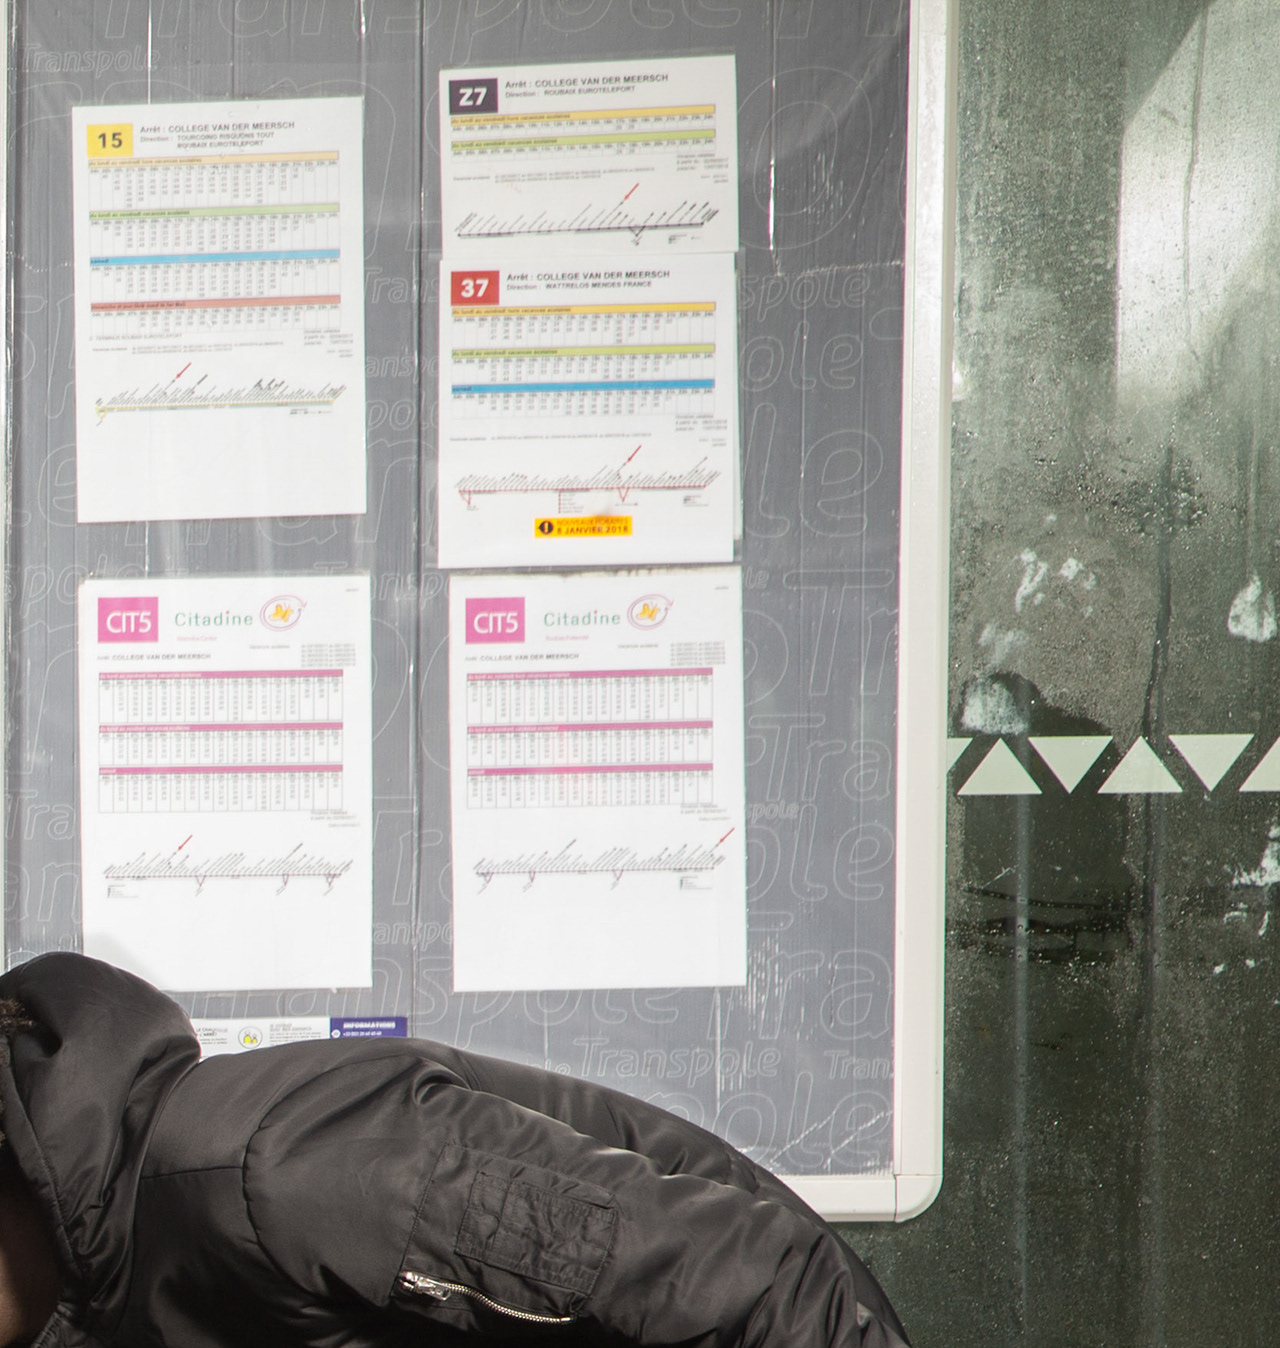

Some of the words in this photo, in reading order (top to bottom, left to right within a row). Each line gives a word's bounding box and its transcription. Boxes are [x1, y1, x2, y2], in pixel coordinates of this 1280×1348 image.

[506, 80, 526, 88] Arrêt
[535, 78, 578, 87] COLLEGE
[581, 77, 599, 86] VAN
[601, 76, 620, 85] DER
[623, 75, 668, 84] MEERSCH
[459, 87, 487, 106] Z7
[141, 125, 160, 133] Arrêt
[169, 123, 209, 132] COLLEGE
[213, 123, 230, 131] VAN
[232, 122, 250, 130] DER
[253, 122, 294, 130] MEERSCH
[98, 132, 122, 149] 15
[507, 273, 527, 281] Arrêt
[537, 273, 580, 281] COLLEGE
[461, 279, 489, 297] 37
[605, 525, 628, 533] 2018
[107, 611, 151, 633] CIT5
[175, 611, 253, 626] Citadine
[474, 612, 518, 633] CIT5
[544, 610, 620, 626] Citadine
